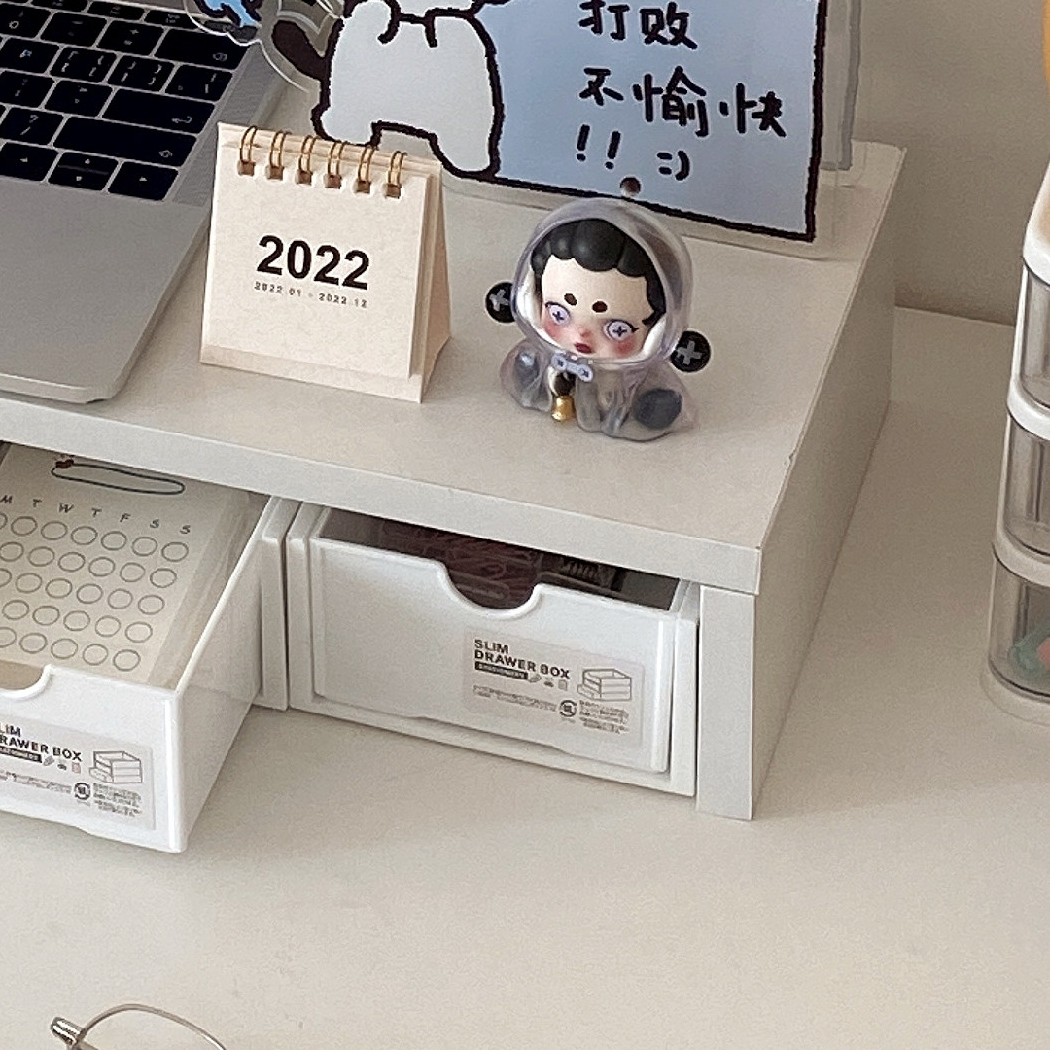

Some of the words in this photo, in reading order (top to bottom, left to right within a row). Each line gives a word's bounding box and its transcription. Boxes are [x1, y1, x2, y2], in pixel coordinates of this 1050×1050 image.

[578, 65, 787, 138] 不愉快
[257, 234, 370, 291] 2022
[475, 640, 509, 654] SLIM
[475, 650, 536, 672] DRAWER
[540, 664, 570, 680] BOX
[52, 747, 82, 762] BOX
